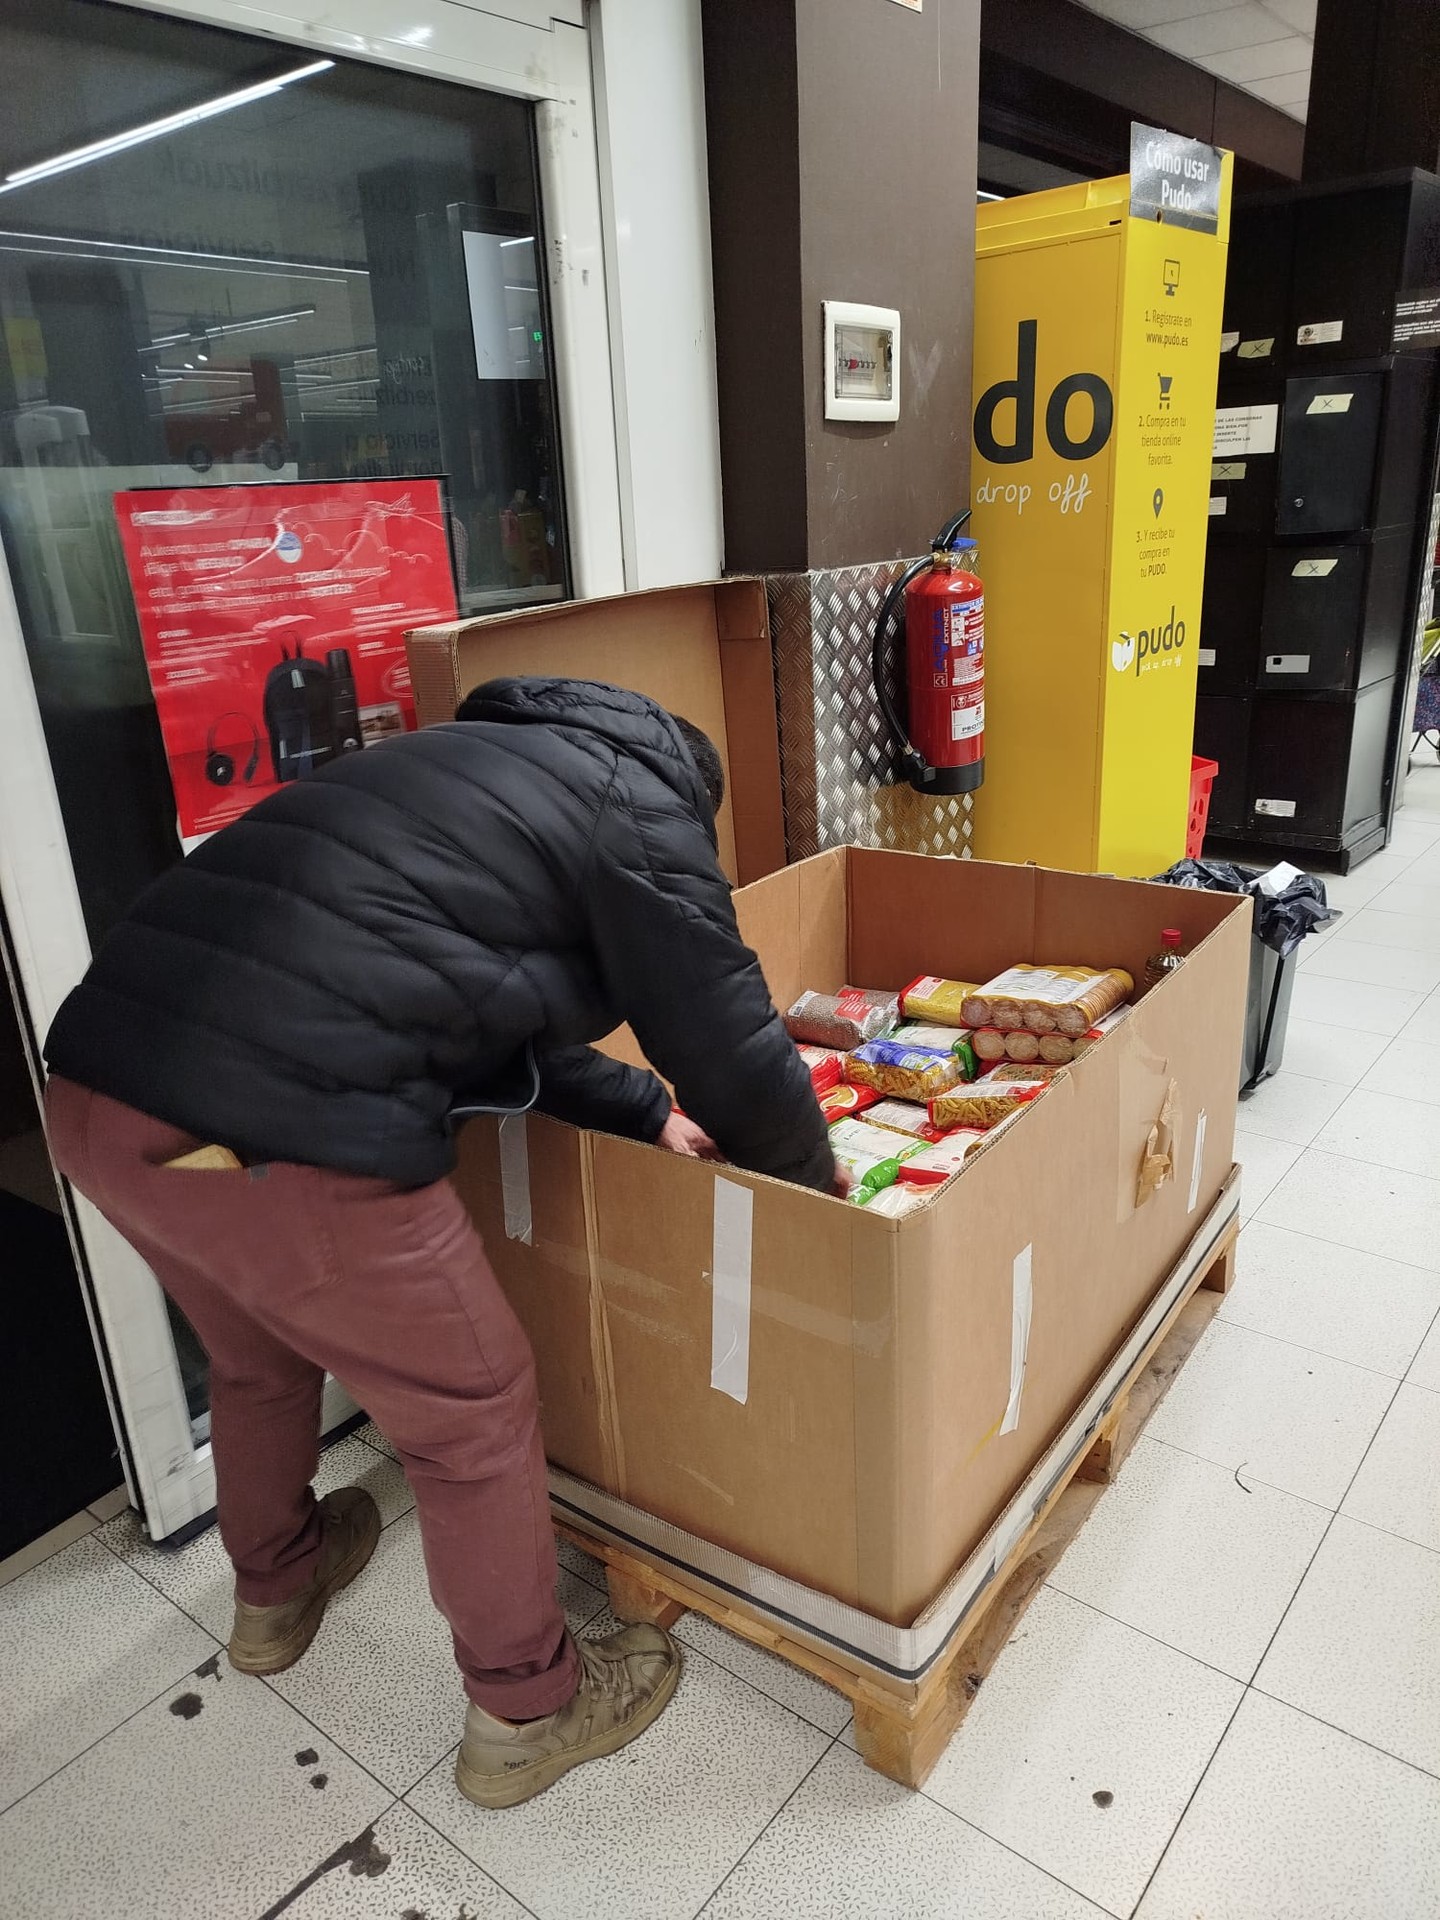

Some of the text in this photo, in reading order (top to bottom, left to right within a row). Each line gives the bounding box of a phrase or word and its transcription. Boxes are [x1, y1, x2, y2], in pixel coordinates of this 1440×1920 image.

[1183, 157, 1210, 182] usar
[1161, 179, 1192, 210] Pudo
[1145, 310, 1151, 322] 1.
[1184, 317, 1192, 327] en
[1146, 332, 1189, 348] www.pudo.es
[1138, 414, 1186, 430] 2. Compra en tu
[1141, 432, 1182, 447] tienda online
[976, 472, 1092, 515] drop off
[1136, 530, 1143, 543] 3.
[1144, 529, 1149, 541] Y
[1149, 527, 1168, 540] recibe
[1139, 547, 1170, 561] compra en
[1140, 567, 1147, 578] tu
[1136, 605, 1186, 677] pudo
